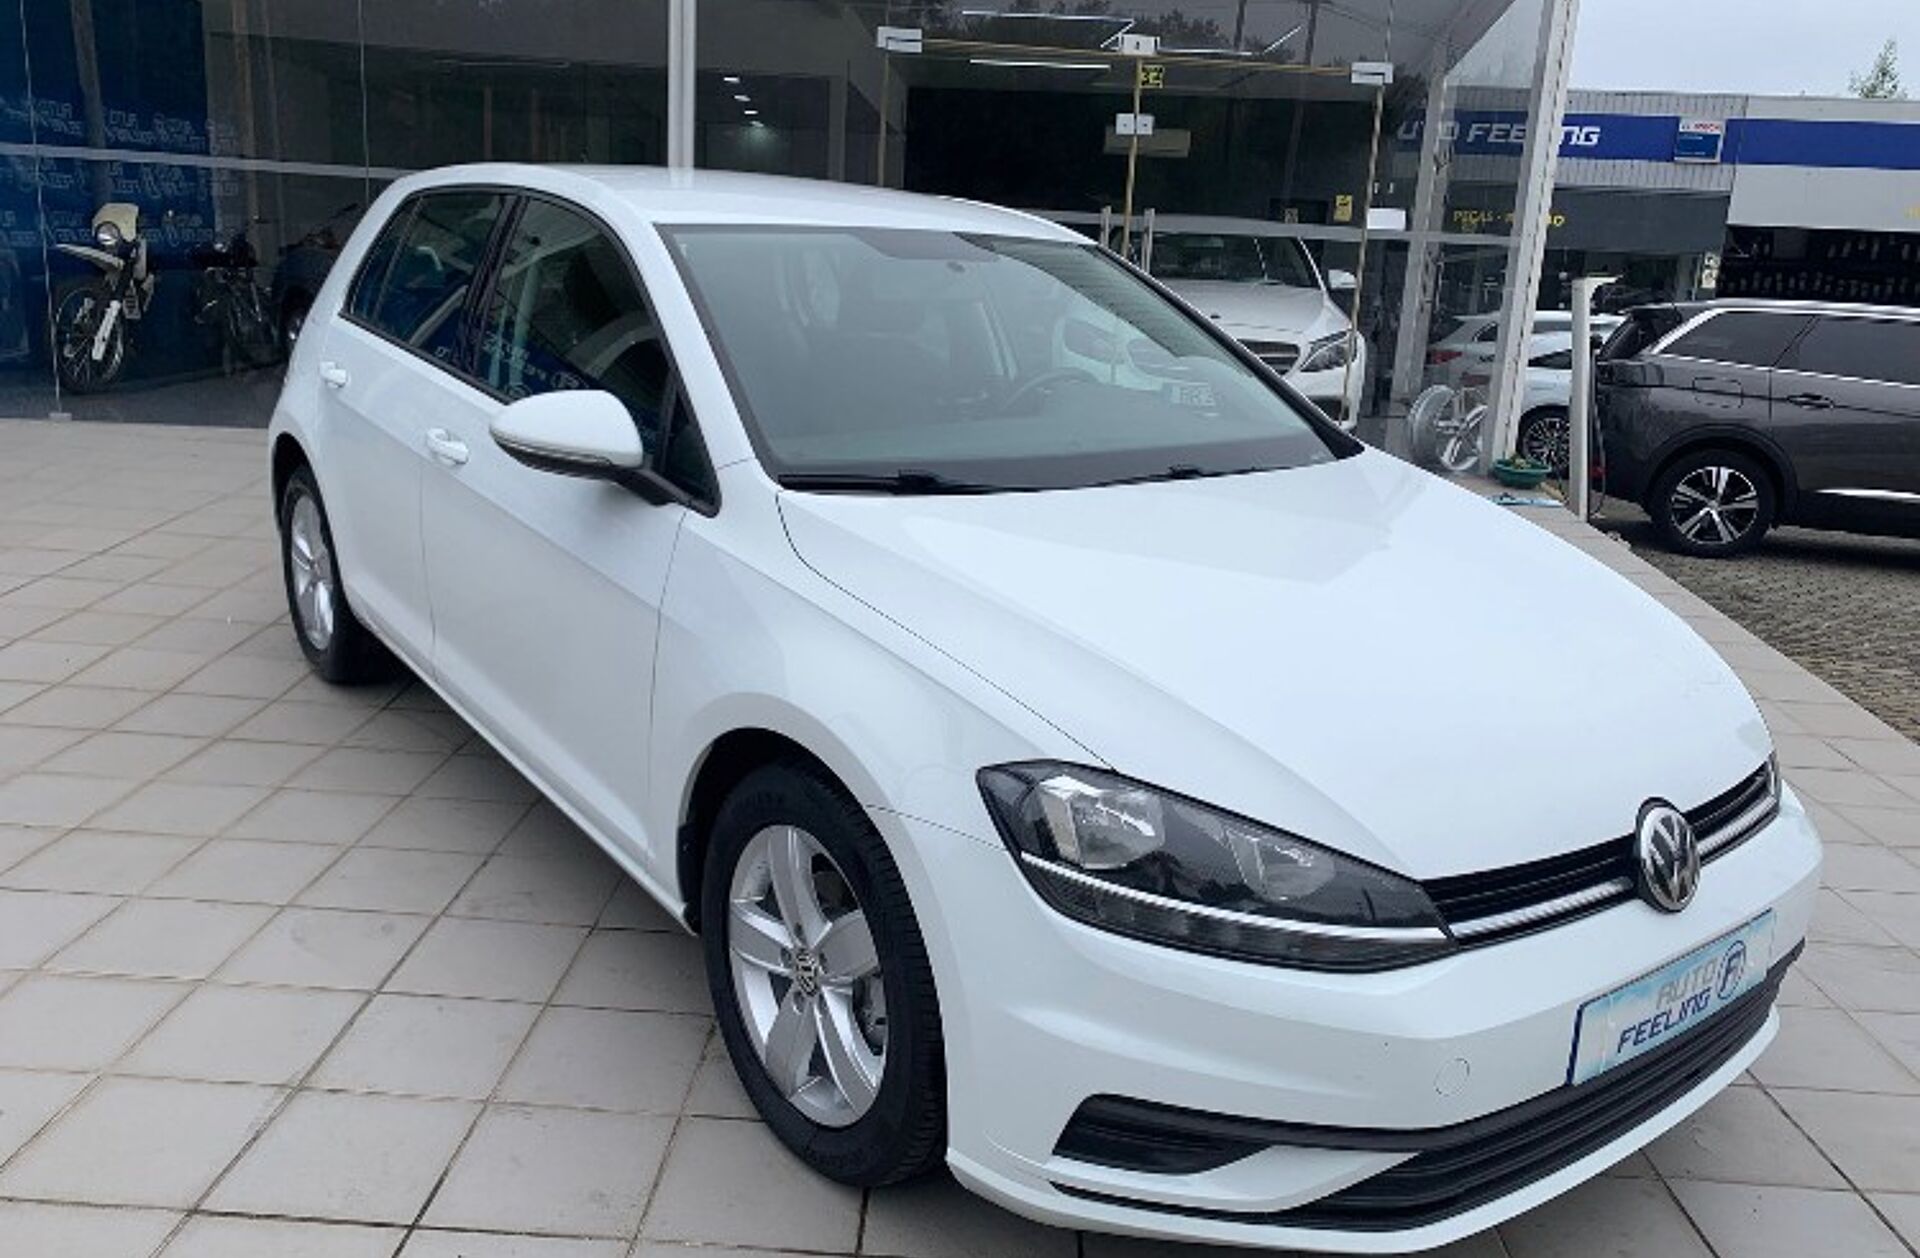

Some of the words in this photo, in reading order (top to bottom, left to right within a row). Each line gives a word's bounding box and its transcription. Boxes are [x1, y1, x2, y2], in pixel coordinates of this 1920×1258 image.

[1466, 123, 1601, 146] FEENG
[1657, 957, 1718, 1009] AUTO
[1617, 987, 1712, 1054] FEELING
